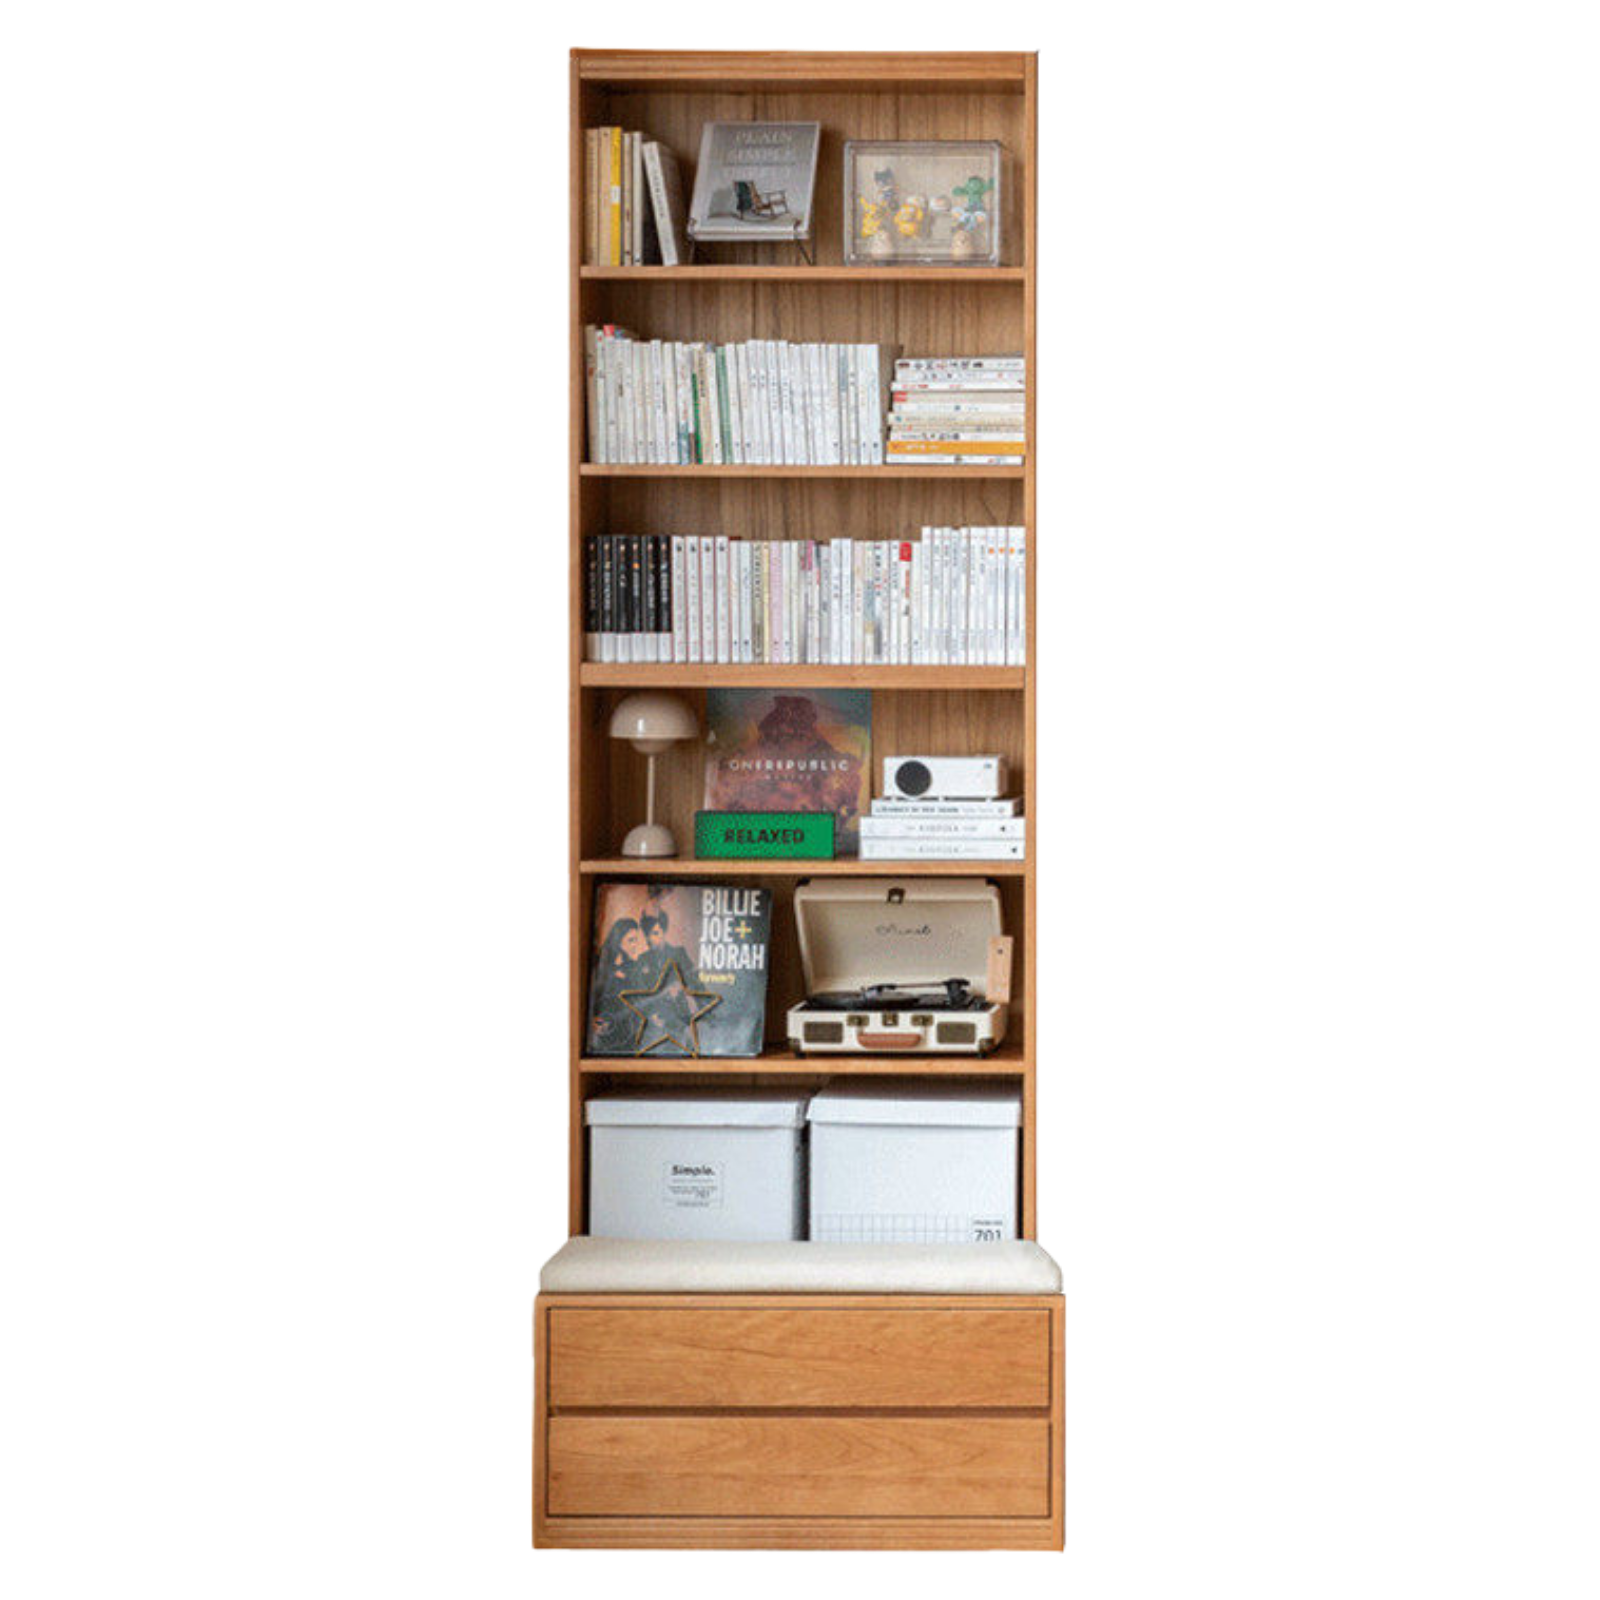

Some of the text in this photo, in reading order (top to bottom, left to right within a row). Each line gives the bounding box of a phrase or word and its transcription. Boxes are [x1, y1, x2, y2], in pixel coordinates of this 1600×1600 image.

[729, 759, 849, 771] ONEREPUBLIC
[724, 828, 804, 845] RELAXED
[702, 889, 760, 916] BILLIE
[698, 942, 764, 970] NORAH
[974, 1228, 1001, 1242] 701
